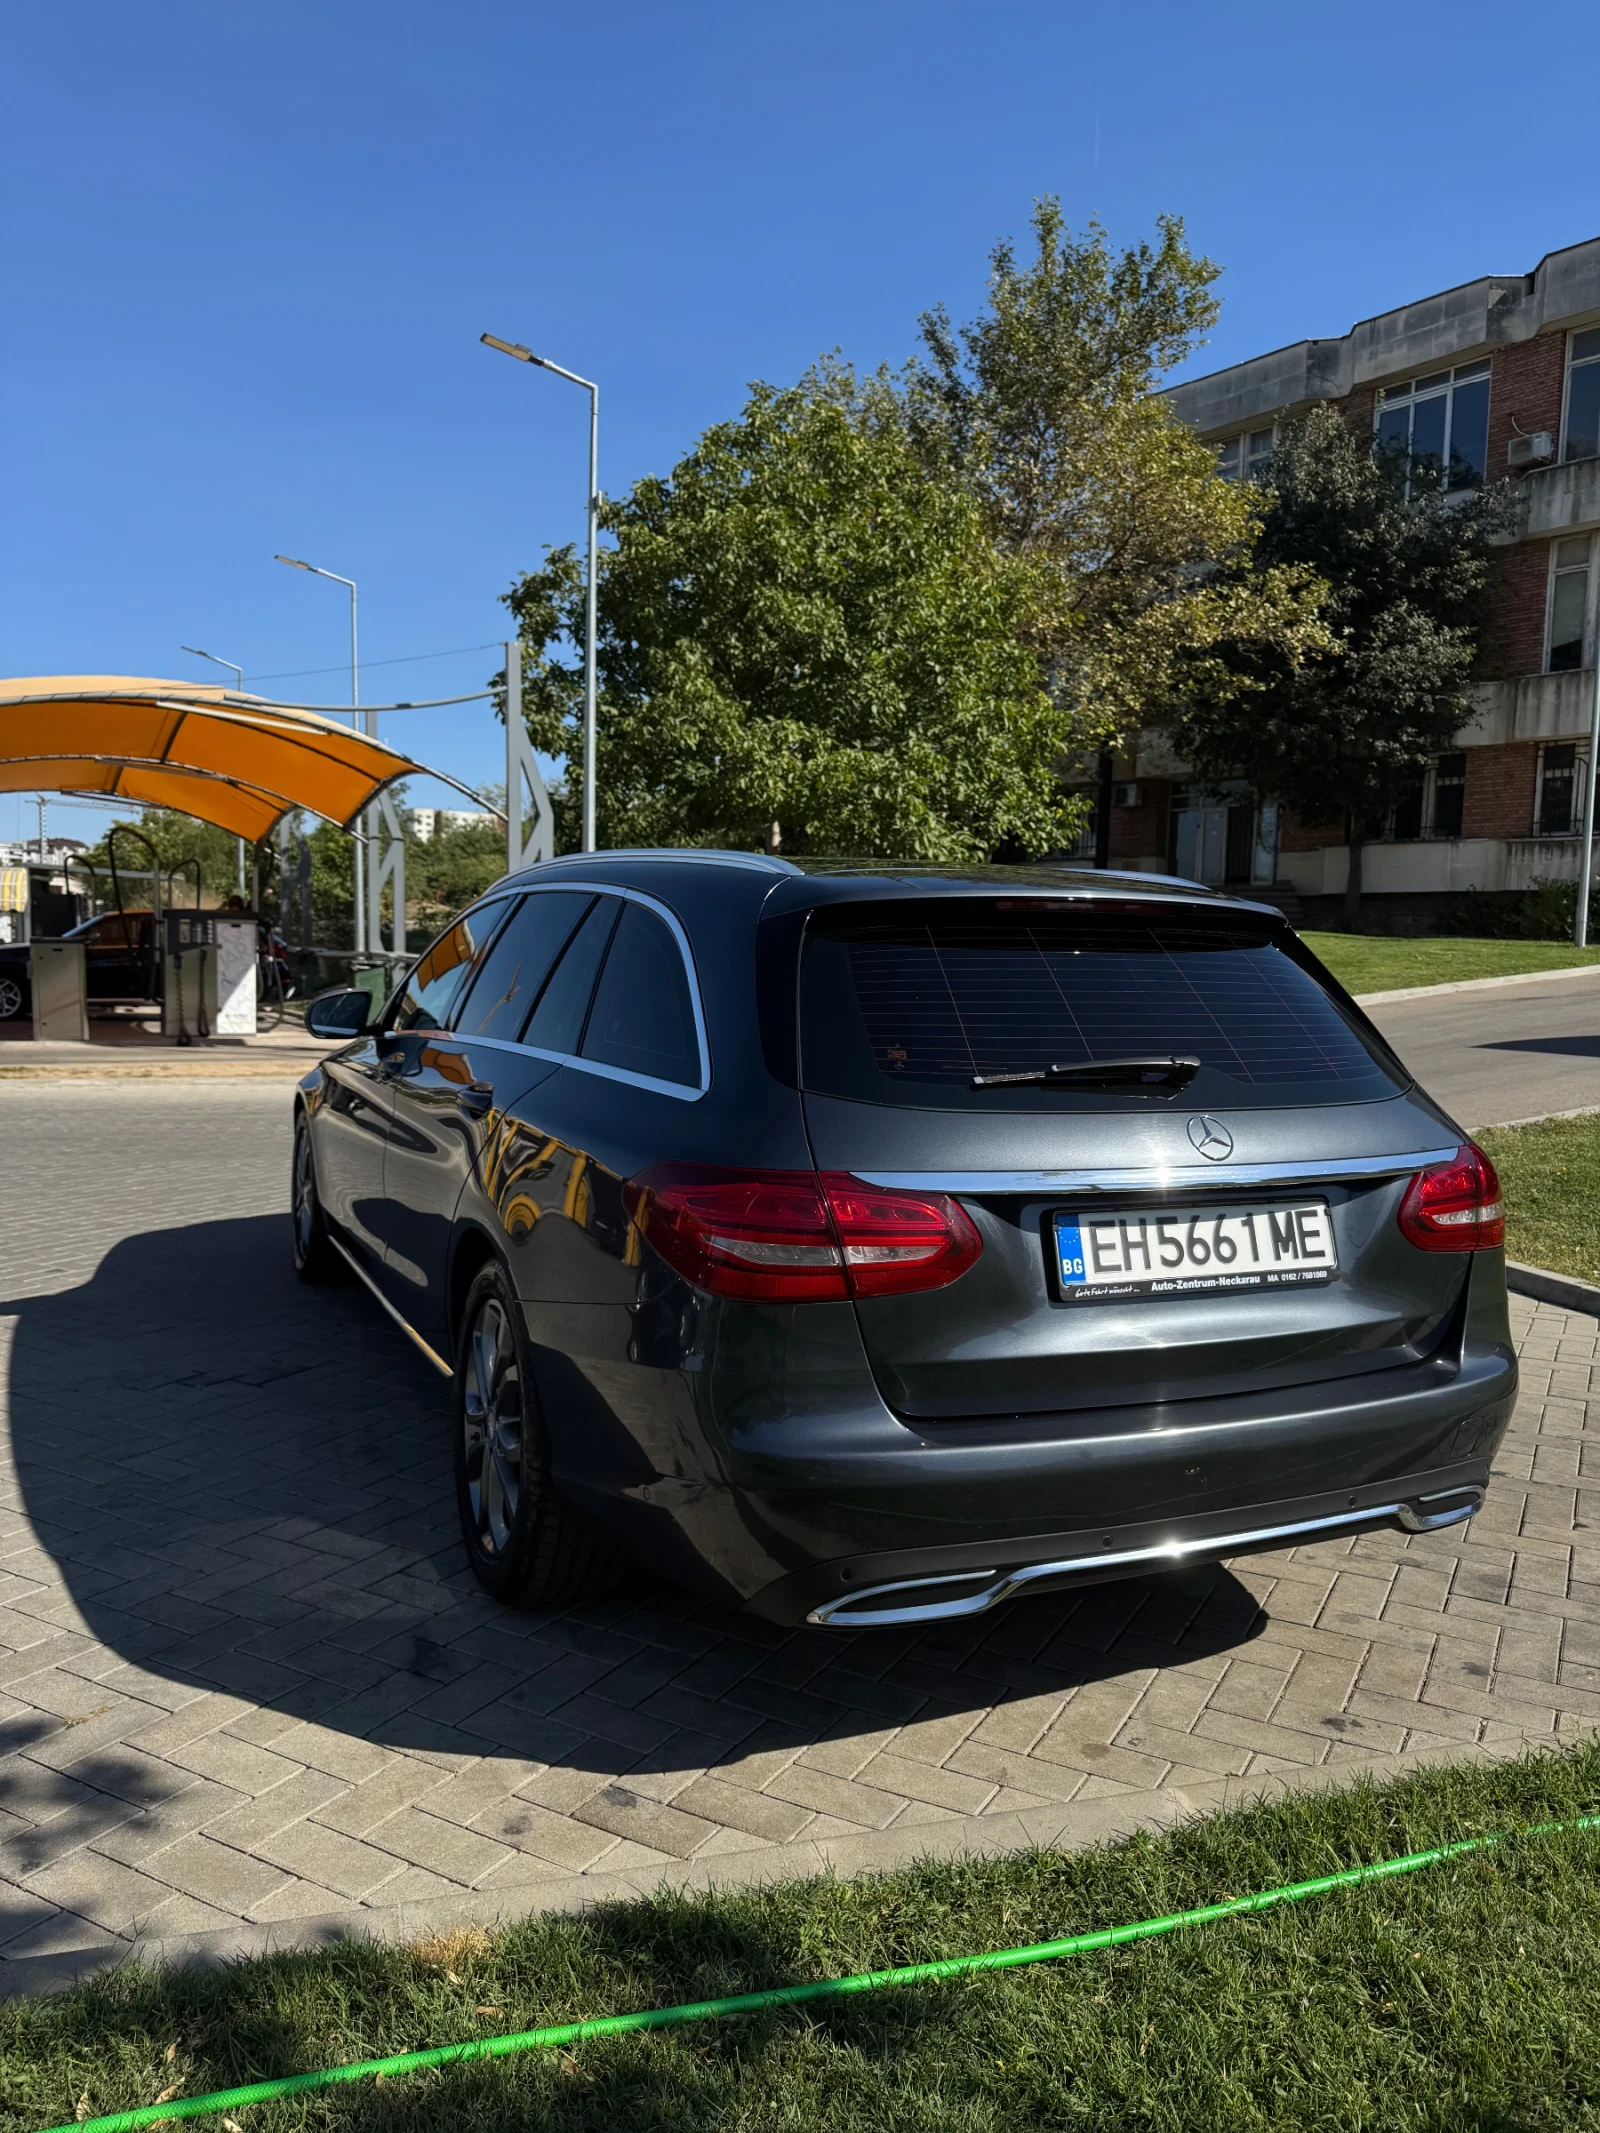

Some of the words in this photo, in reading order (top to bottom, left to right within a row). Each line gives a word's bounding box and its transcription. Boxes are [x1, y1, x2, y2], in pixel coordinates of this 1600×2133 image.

[1062, 1258, 1083, 1275] BG
[1151, 1276, 1260, 1291] Auto-Zentrum-Neckarau
[1267, 1274, 1280, 1282] MA
